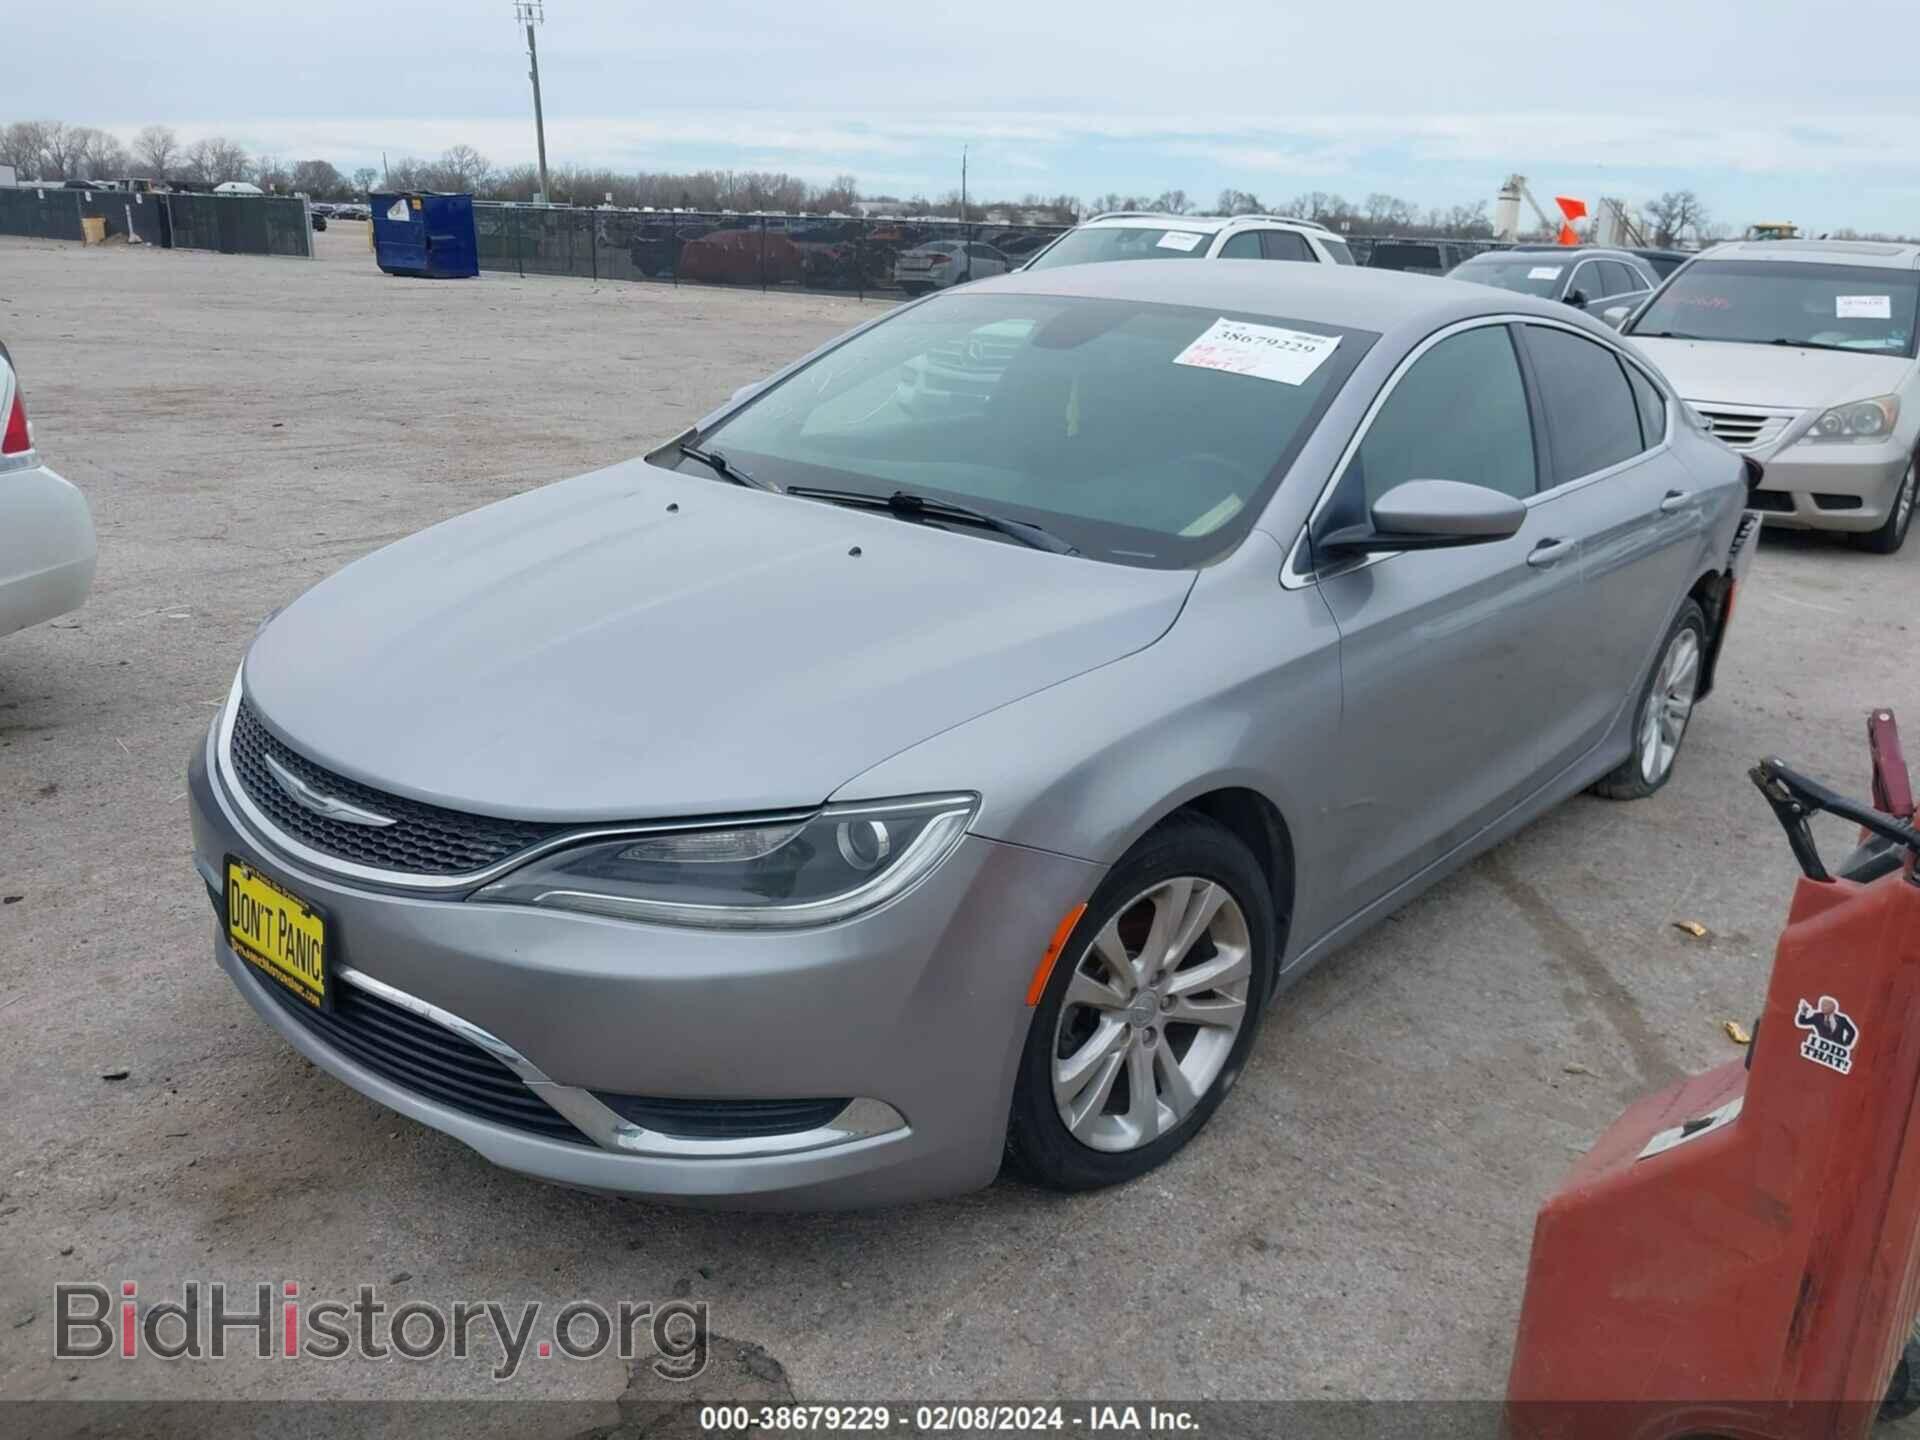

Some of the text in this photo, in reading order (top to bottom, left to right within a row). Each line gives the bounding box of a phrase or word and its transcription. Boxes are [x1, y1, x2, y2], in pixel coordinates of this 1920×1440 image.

[231, 878, 273, 949] DON'T
[1804, 1045, 1849, 1071] THAT!
[1818, 1040, 1847, 1058] DID
